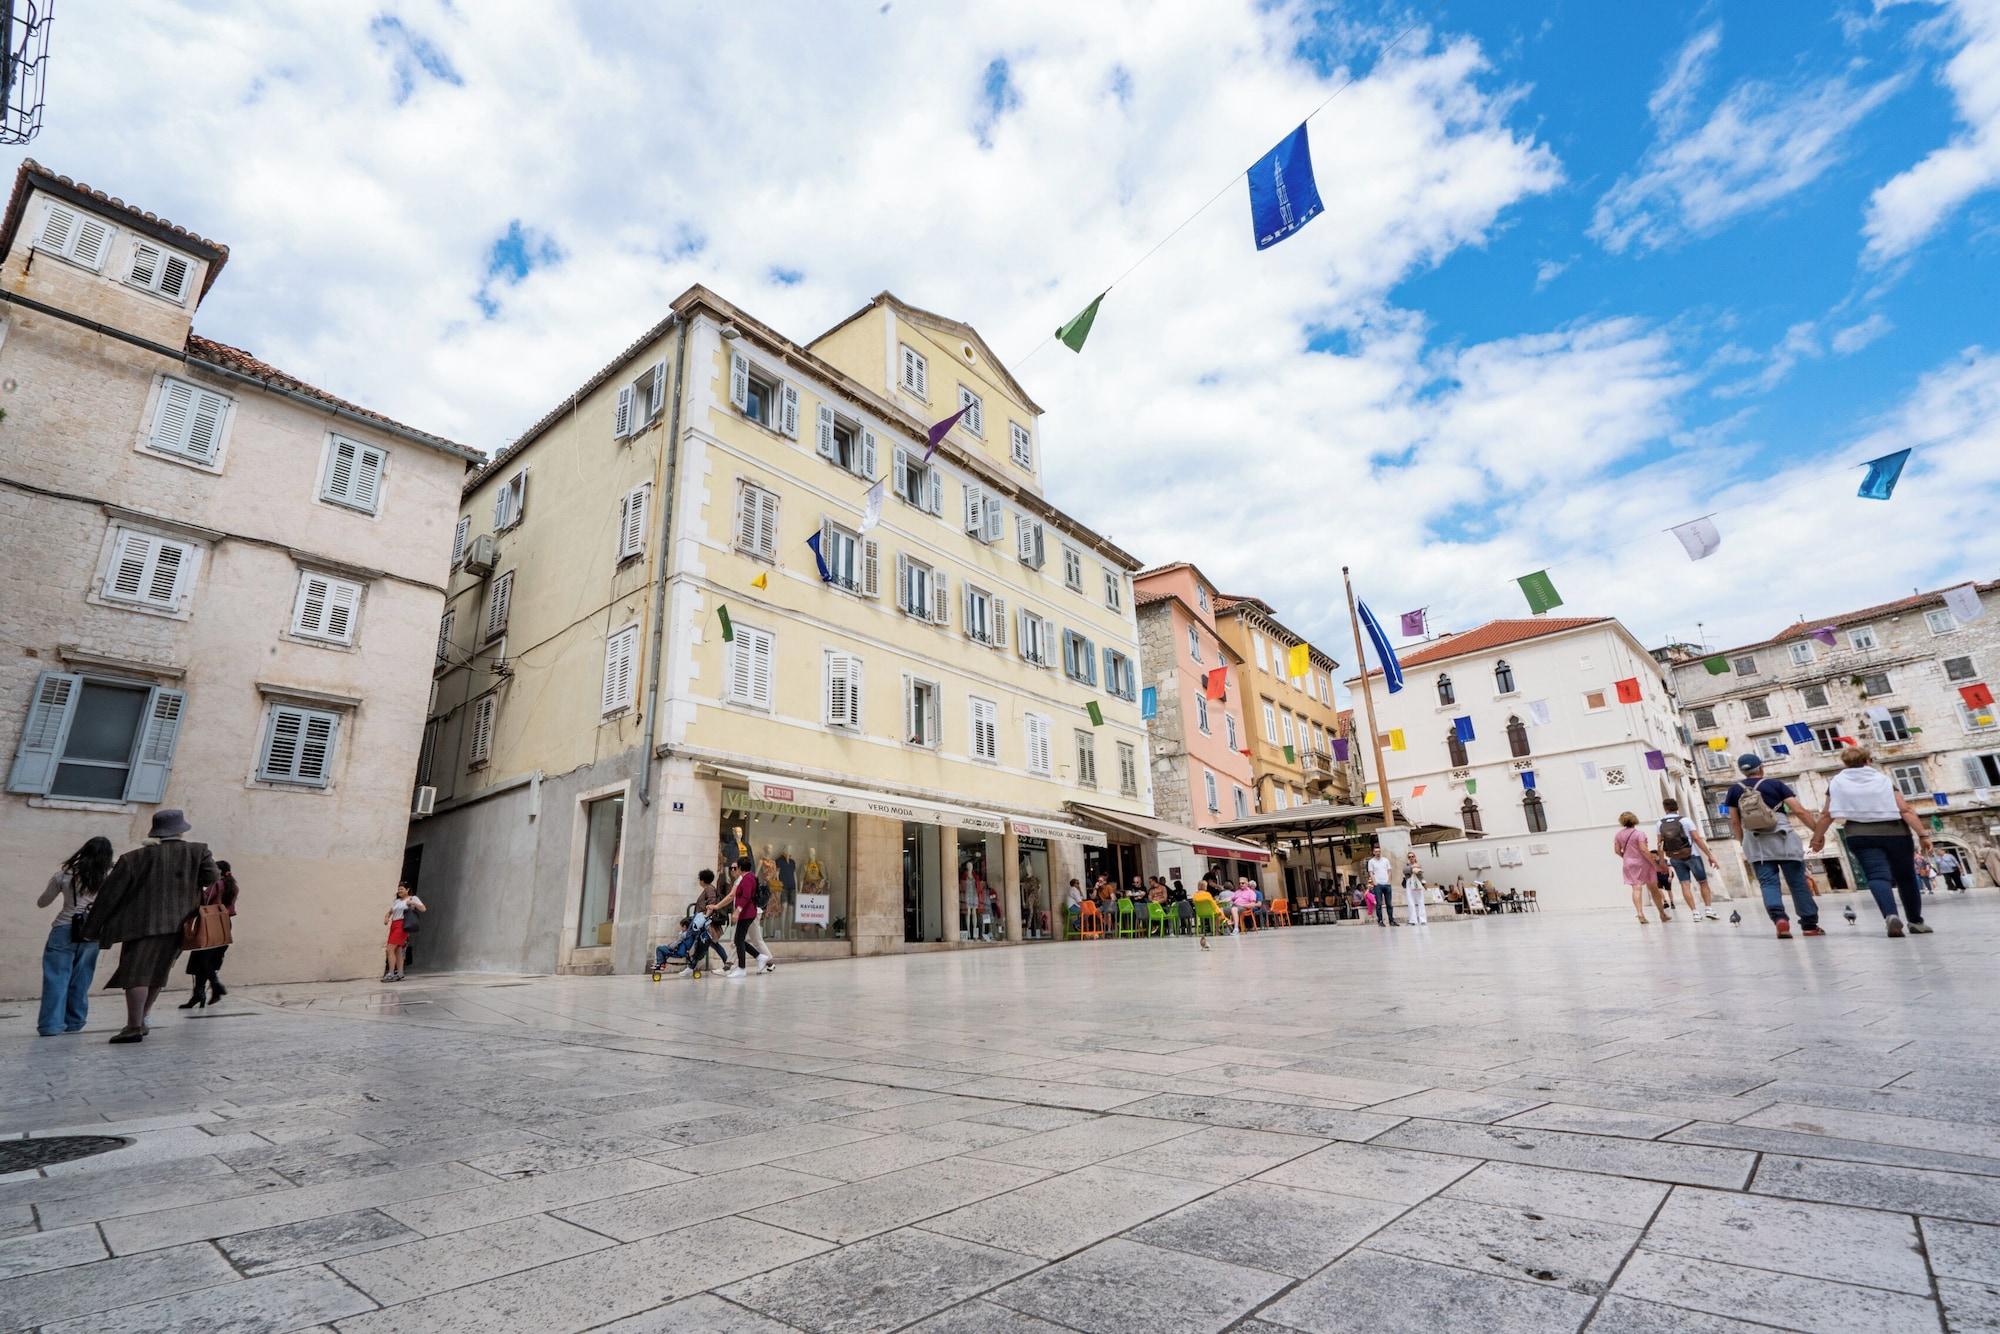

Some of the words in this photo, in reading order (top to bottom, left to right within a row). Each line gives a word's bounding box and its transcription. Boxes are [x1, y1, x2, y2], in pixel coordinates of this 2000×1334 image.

[1261, 204, 1317, 246] SPLIT
[868, 803, 889, 813] VERO
[890, 807, 913, 817] MODA
[962, 818, 976, 826] JACK
[982, 820, 1000, 829] JONES
